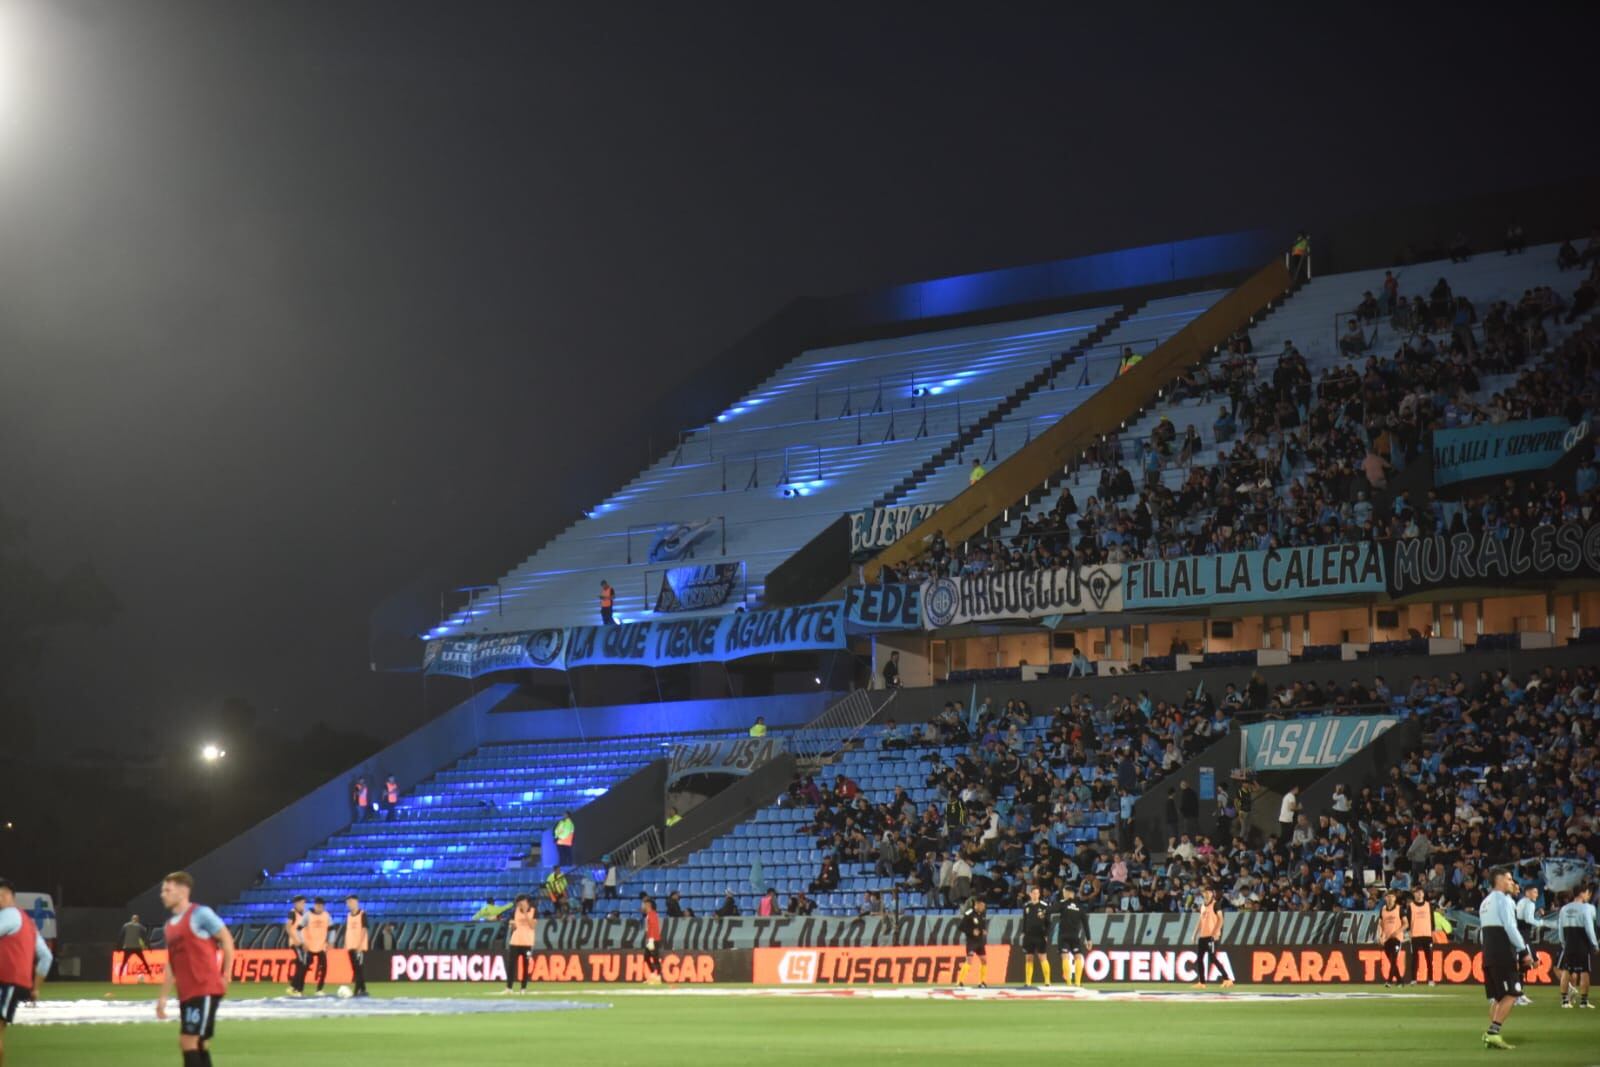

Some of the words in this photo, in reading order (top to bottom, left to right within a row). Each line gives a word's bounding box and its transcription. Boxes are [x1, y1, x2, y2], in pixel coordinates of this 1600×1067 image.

[849, 503, 945, 554] EJERC
[1126, 559, 1206, 601] FILIAL
[1214, 553, 1252, 594] LA
[1262, 541, 1384, 592] CALERA
[1393, 522, 1584, 591] MURALES
[845, 585, 920, 623] FEDE
[571, 626, 595, 660] LA
[602, 622, 647, 660] QUE
[656, 617, 717, 659] TIENE
[725, 604, 838, 655] AGUANTE
[391, 953, 508, 981] POTENCIA
[589, 953, 621, 982] TU
[1252, 951, 1350, 983] PARA
[1416, 950, 1552, 983] HOR
[185, 1006, 201, 1023] 16
